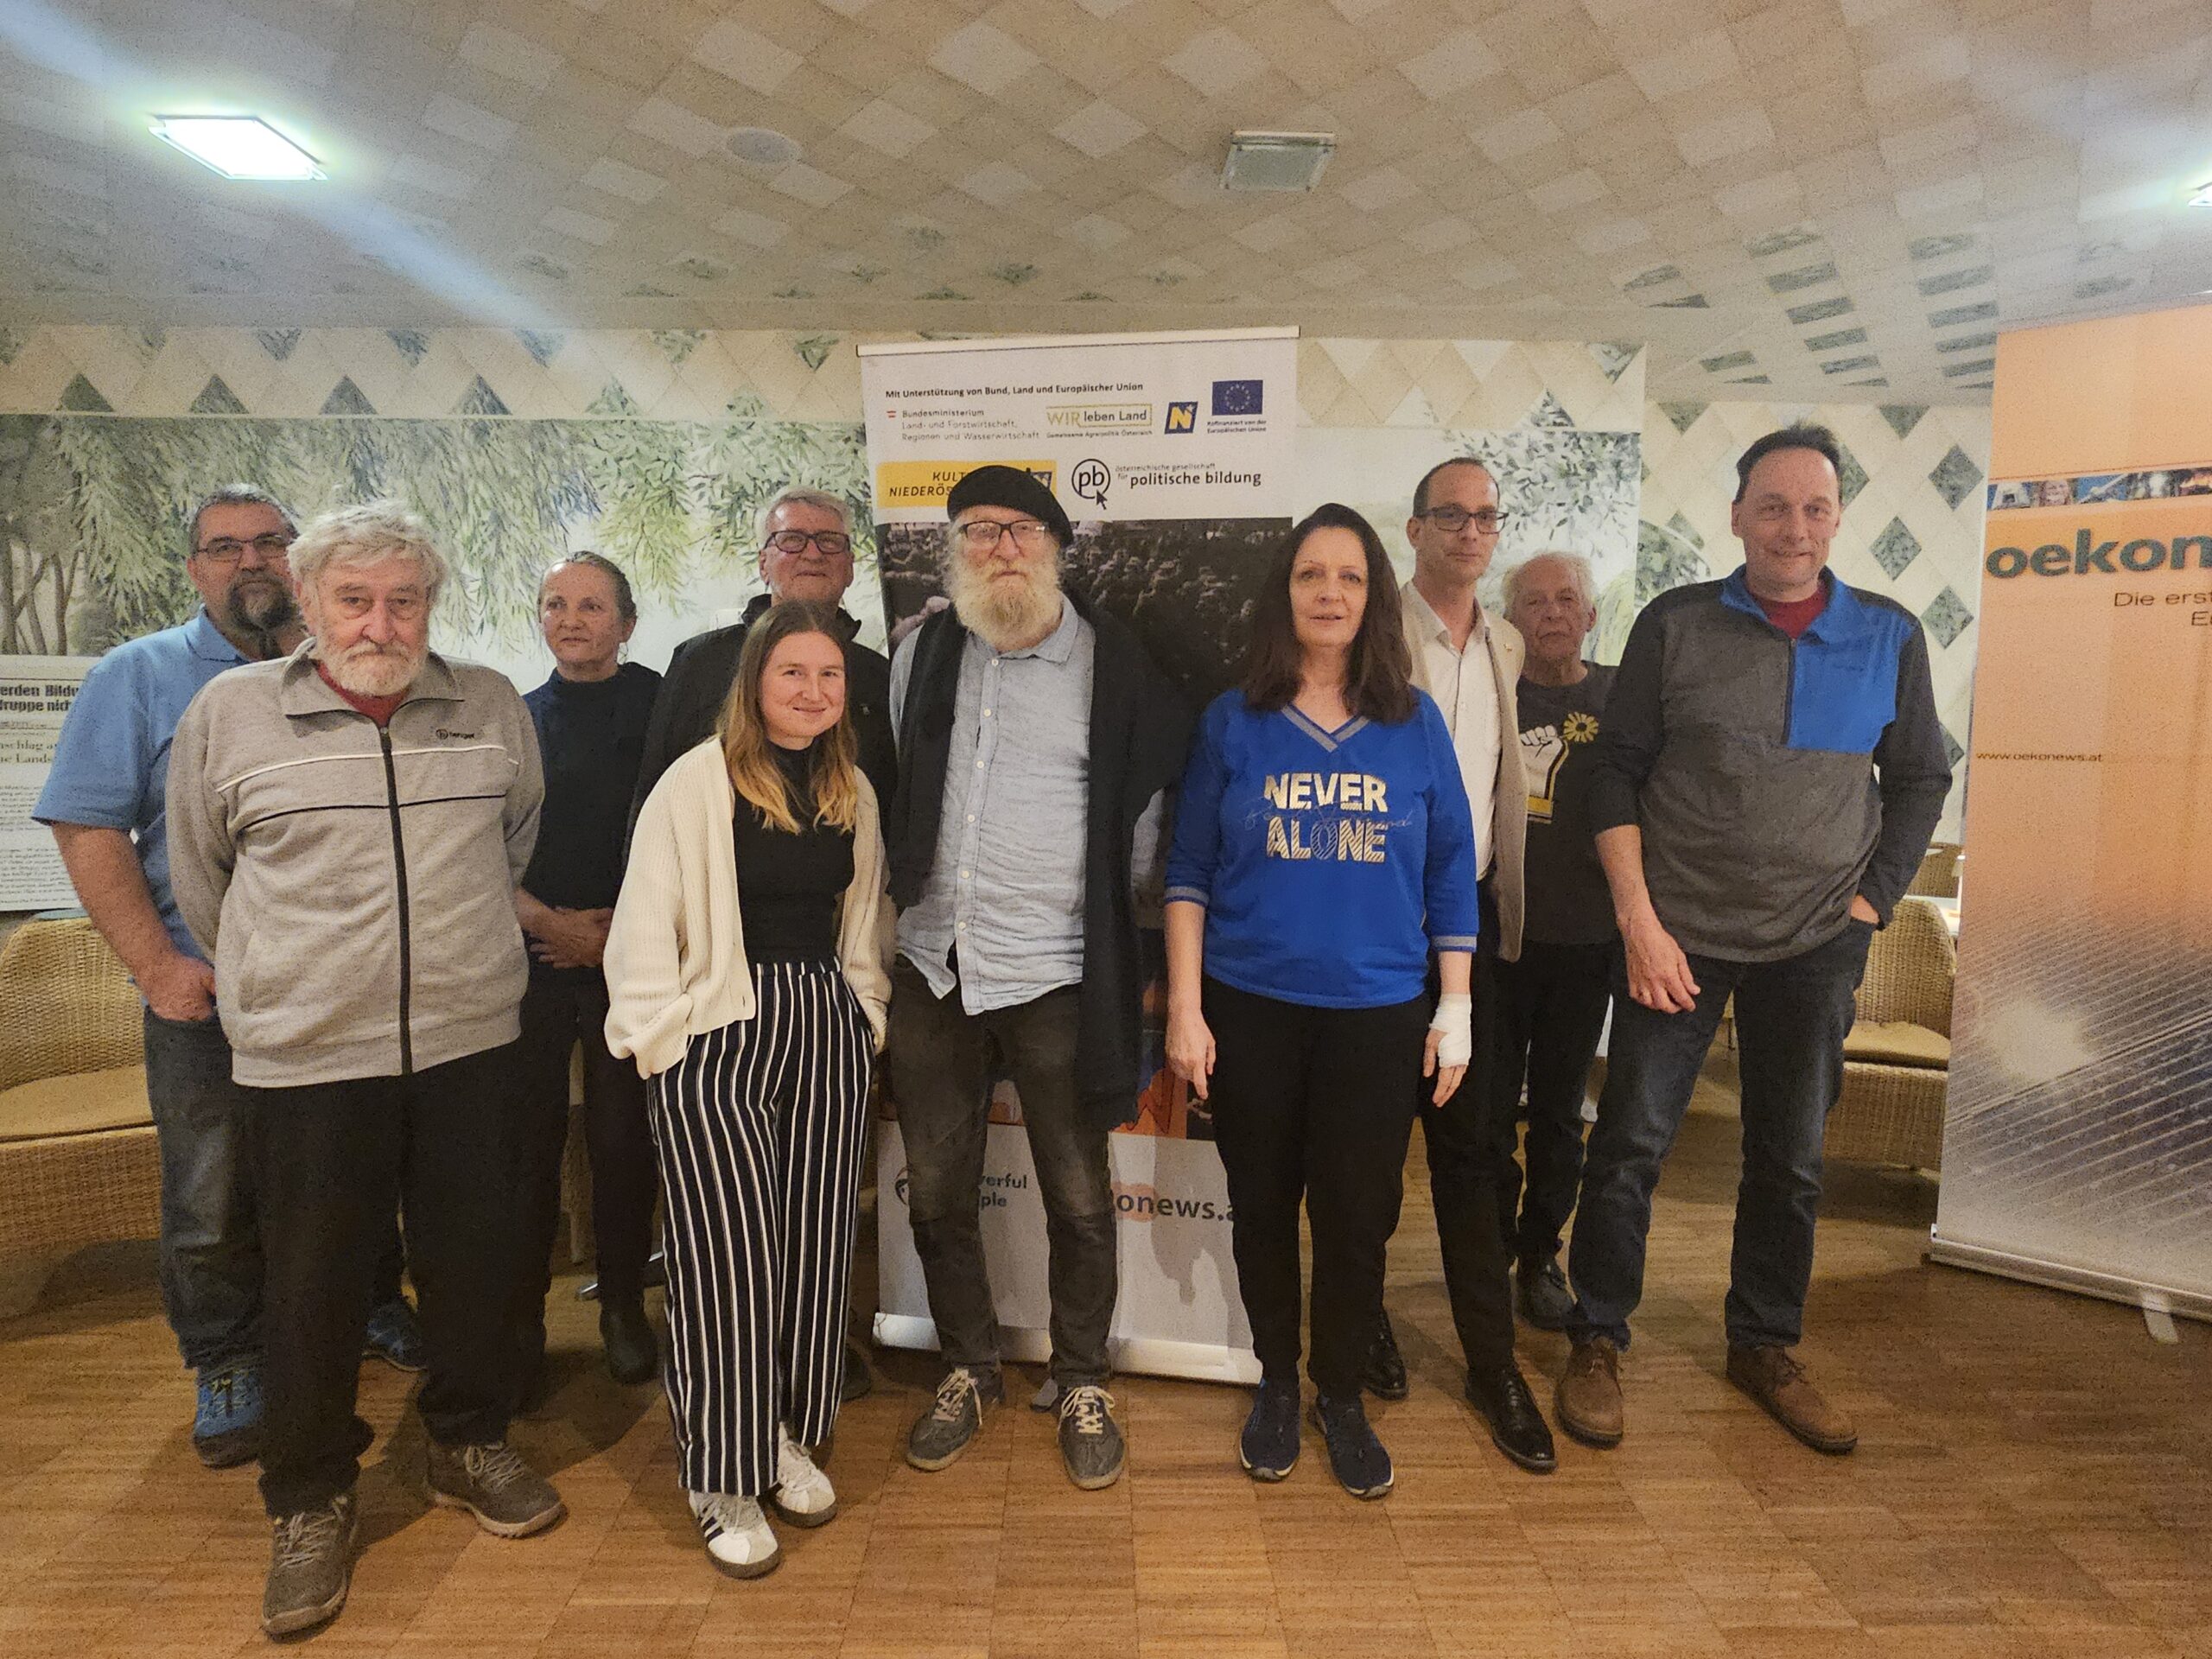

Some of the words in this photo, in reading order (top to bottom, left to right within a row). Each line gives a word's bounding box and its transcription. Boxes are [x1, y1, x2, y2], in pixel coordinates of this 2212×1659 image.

[902, 388, 964, 397] Unterstützung
[985, 386, 1011, 396] Bund,
[1013, 385, 1033, 394] Land
[1056, 384, 1114, 394] Europäischer
[1116, 382, 1144, 391] Union
[902, 409, 985, 418] Bundesministerium
[1046, 411, 1081, 427] WIR
[1084, 410, 1116, 422] leben
[1119, 409, 1147, 421] Land
[928, 420, 945, 429] und
[902, 433, 941, 442] Regionen
[964, 430, 1039, 440] Wasserwirtschaft
[932, 471, 971, 482] KULT
[1078, 465, 1105, 497] pb
[1130, 471, 1201, 489] politische
[1205, 471, 1262, 487] bildung
[889, 482, 951, 498] NIEDERÖS
[1986, 528, 2212, 579] oekon
[2113, 592, 2155, 607] Die
[2191, 610, 2212, 626] E
[1975, 752, 2104, 763] www.oekonews.at
[1263, 772, 1389, 812] NEVER
[1266, 816, 1387, 862] ALONE
[981, 1191, 1007, 1211] ple
